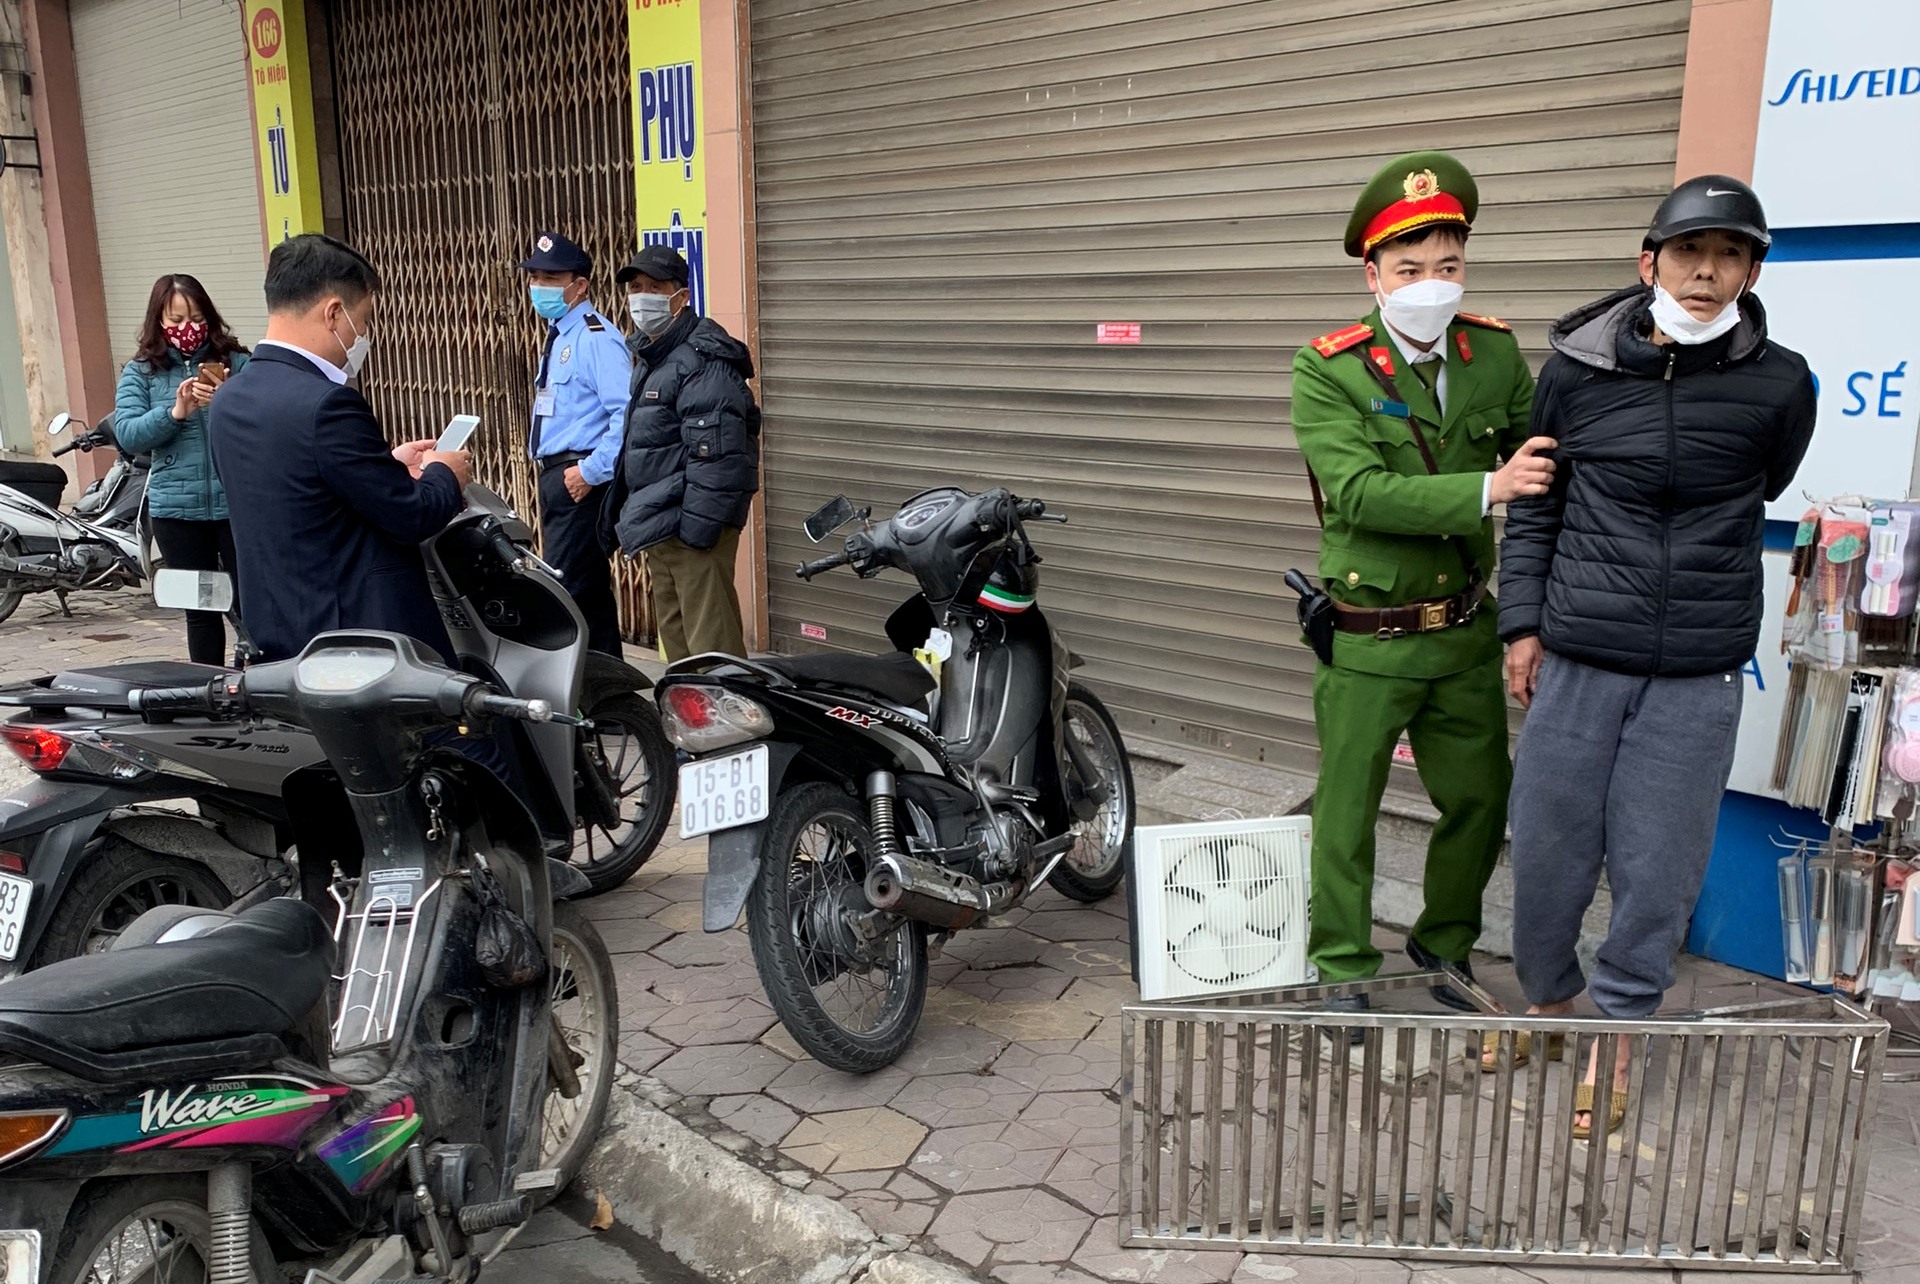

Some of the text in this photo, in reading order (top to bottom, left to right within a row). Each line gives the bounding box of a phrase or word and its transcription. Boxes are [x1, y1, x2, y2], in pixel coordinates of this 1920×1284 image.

[255, 17, 278, 49] 166
[638, 60, 697, 182] PHỤ
[268, 104, 290, 196] TỦ
[1841, 360, 1908, 417] SÉ
[825, 706, 884, 730] MX
[694, 753, 754, 798] 15-B1
[685, 785, 762, 833] 016.68
[138, 1084, 276, 1134] Wave
[206, 1081, 249, 1093] HONDA
